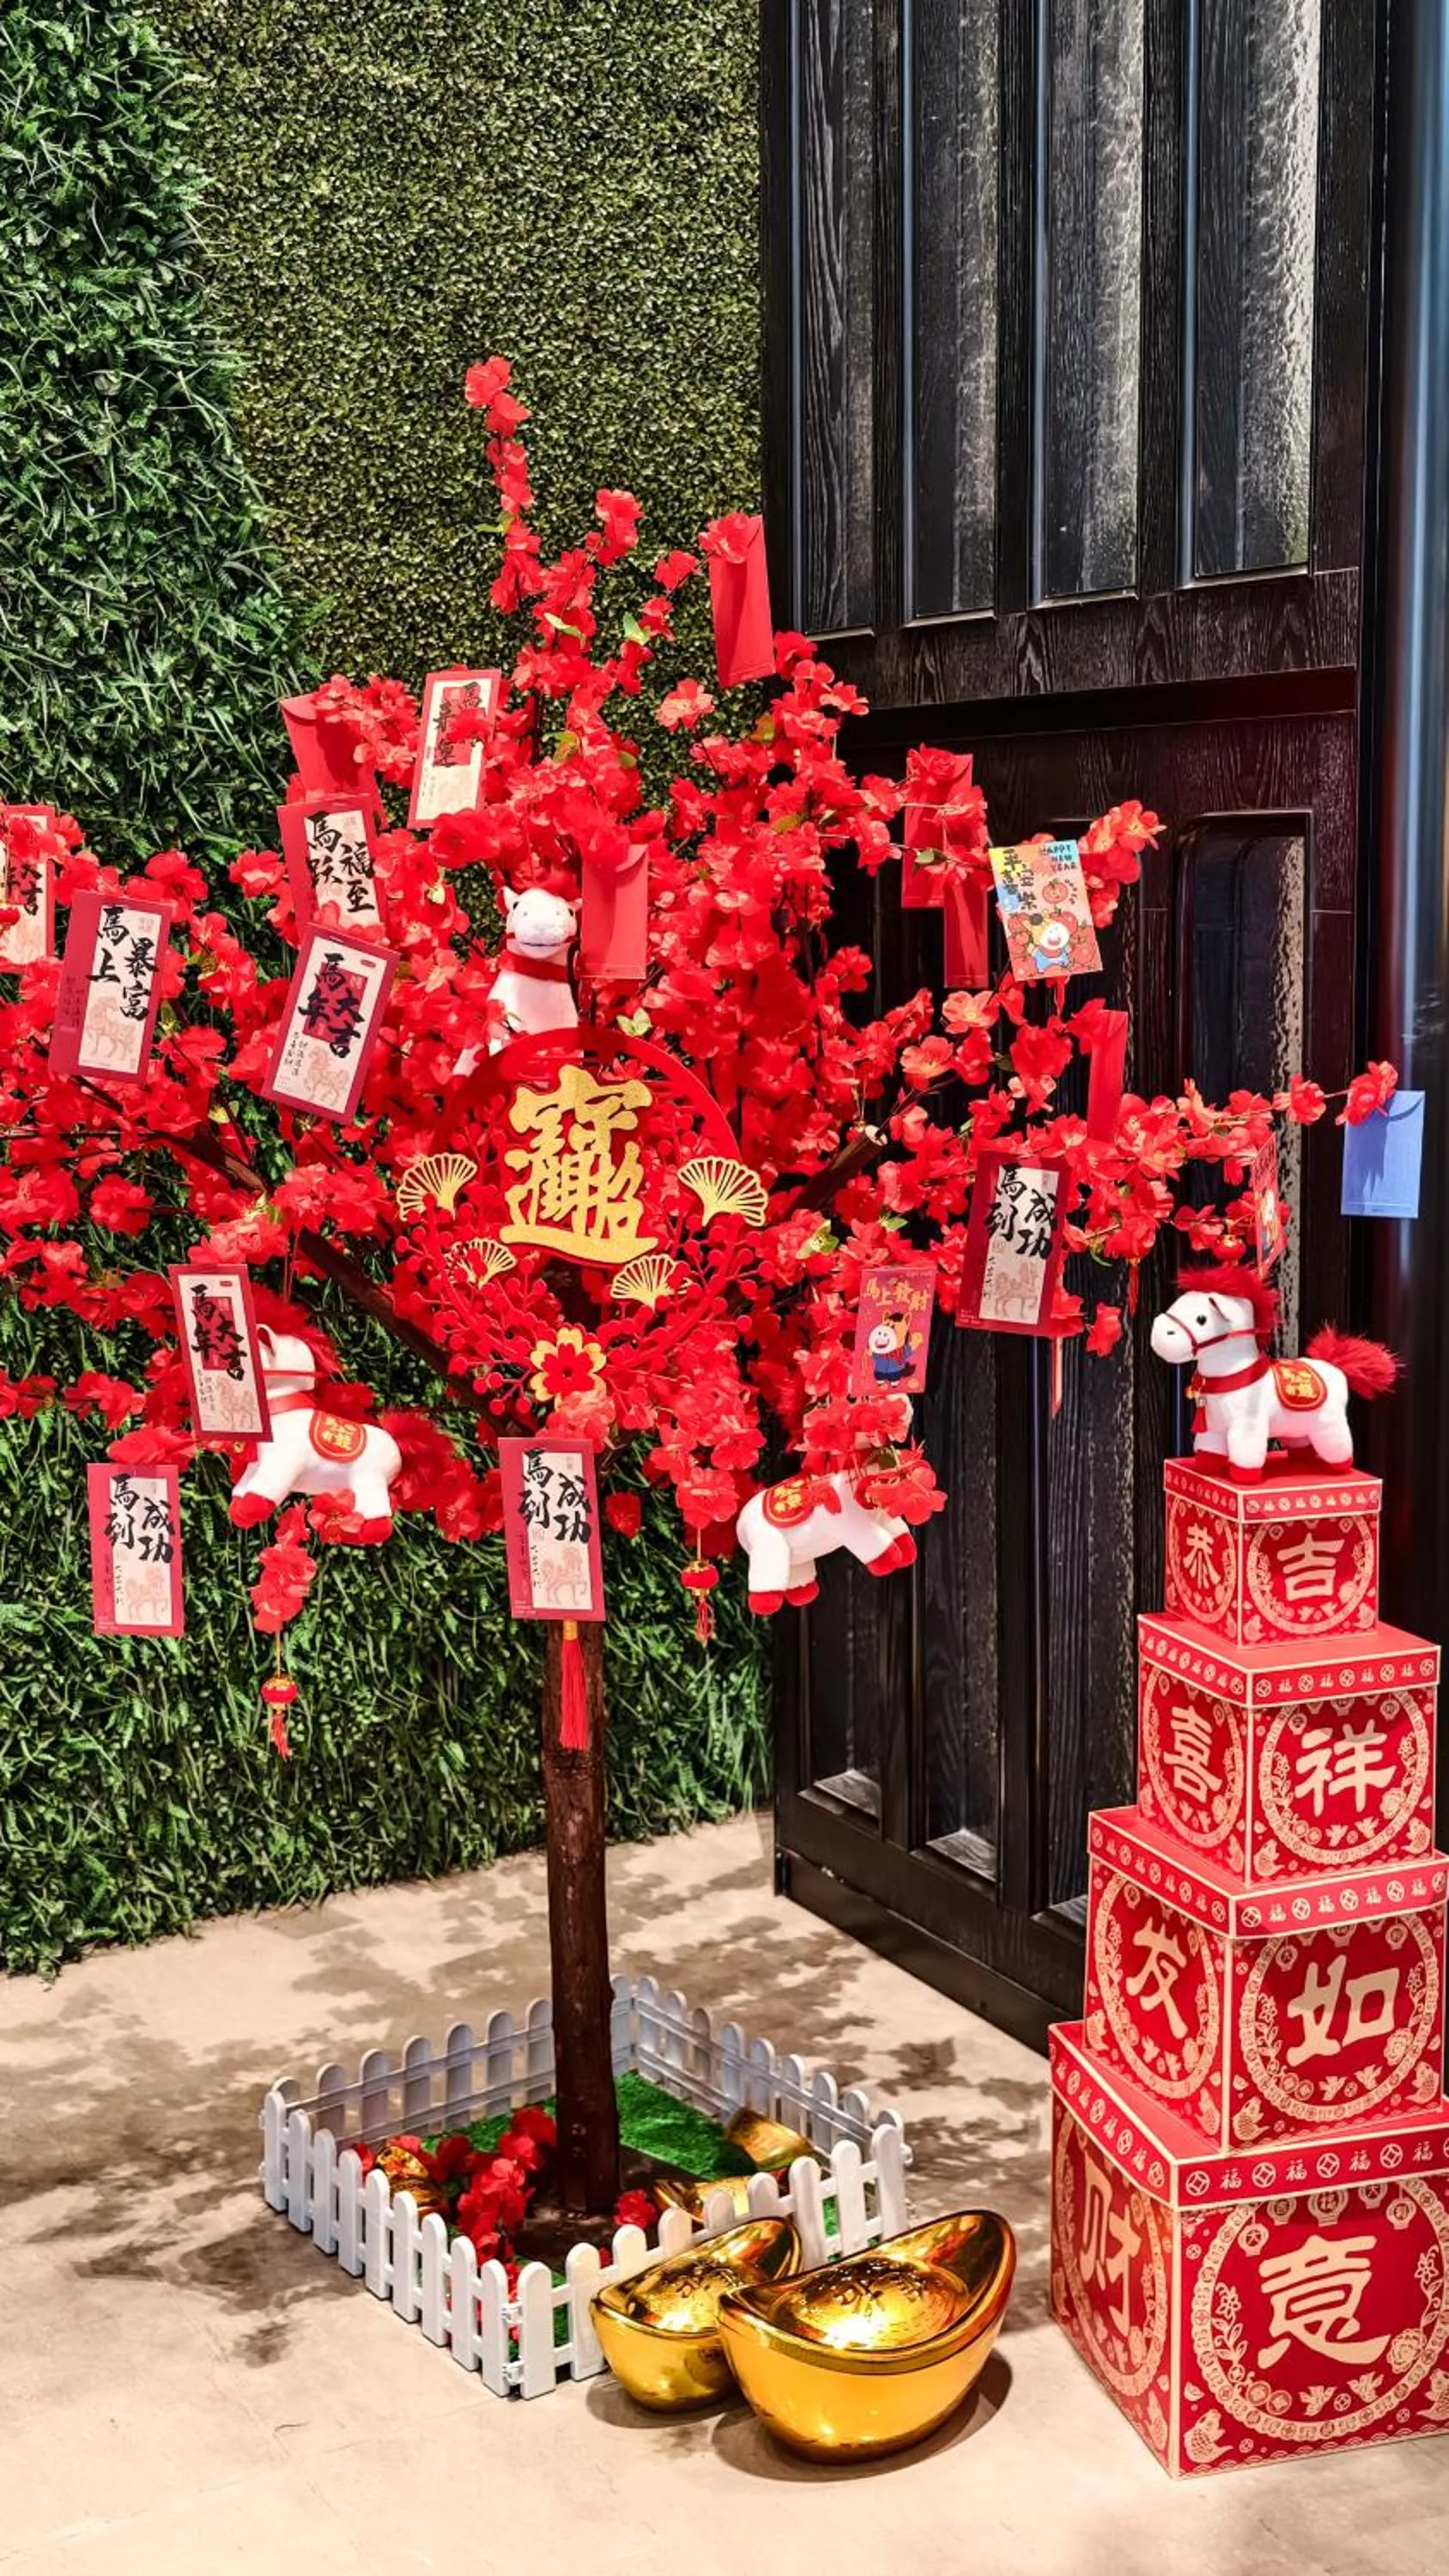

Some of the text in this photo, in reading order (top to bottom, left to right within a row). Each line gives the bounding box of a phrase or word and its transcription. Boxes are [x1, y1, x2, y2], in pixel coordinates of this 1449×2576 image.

[86, 906, 129, 983] 馬上
[120, 937, 160, 1021] 暴富
[328, 988, 365, 1058] 大吉
[1016, 1189, 1057, 1259] 成功
[216, 1312, 247, 1381] 大吉
[137, 1497, 175, 1564] 成功
[553, 1473, 592, 1544] 成功
[1183, 1522, 1222, 1589] 恭
[1276, 1532, 1345, 1602] 吉
[1163, 1704, 1223, 1804] 喜
[1295, 1718, 1397, 1817] 祥
[1287, 1954, 1400, 2067] 如
[1220, 2142, 1434, 2190] 福 福 福 福
[1080, 2151, 1142, 2337] 财
[1257, 2233, 1393, 2370] 意
